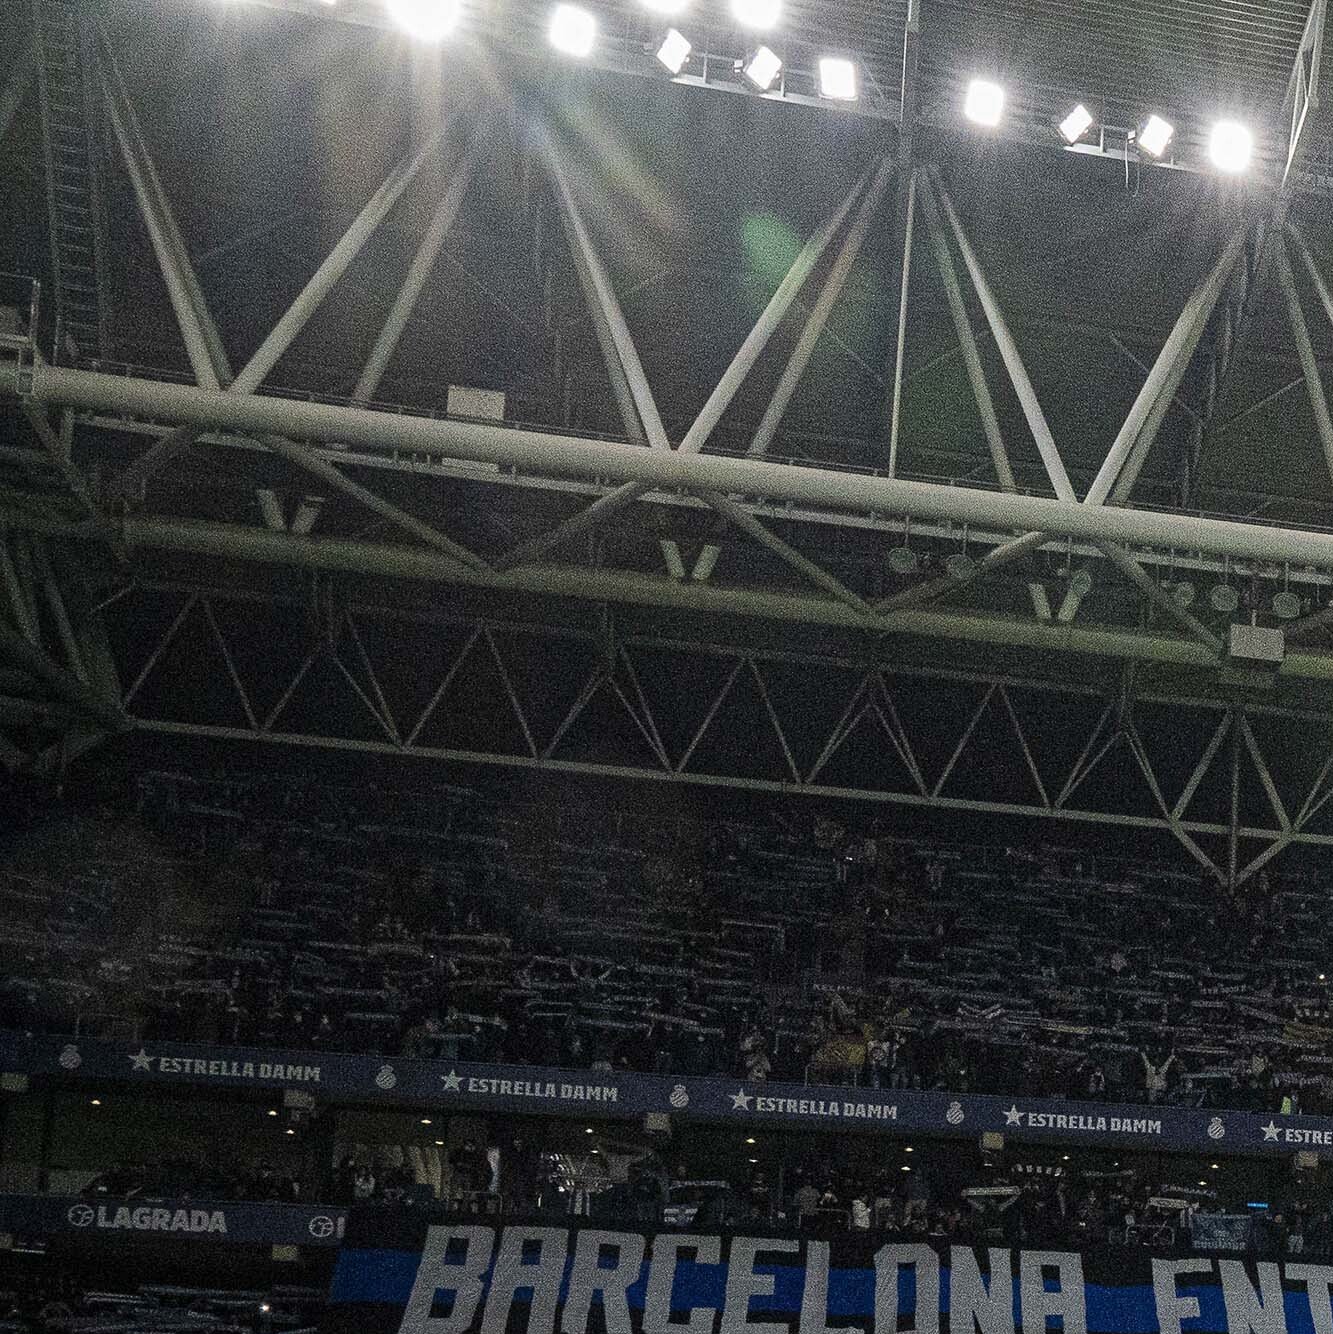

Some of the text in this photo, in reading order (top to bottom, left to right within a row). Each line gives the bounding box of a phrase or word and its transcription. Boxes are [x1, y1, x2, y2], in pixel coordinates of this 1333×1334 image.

[158, 1056, 321, 1083] ESTRELLA DAMM
[467, 1077, 619, 1103] ESTRELLA DAMM
[755, 1096, 899, 1122] ESTRELLA DAMM
[1027, 1112, 1162, 1135] ESTRELLA DAMM
[96, 1205, 228, 1235] LAGRADA
